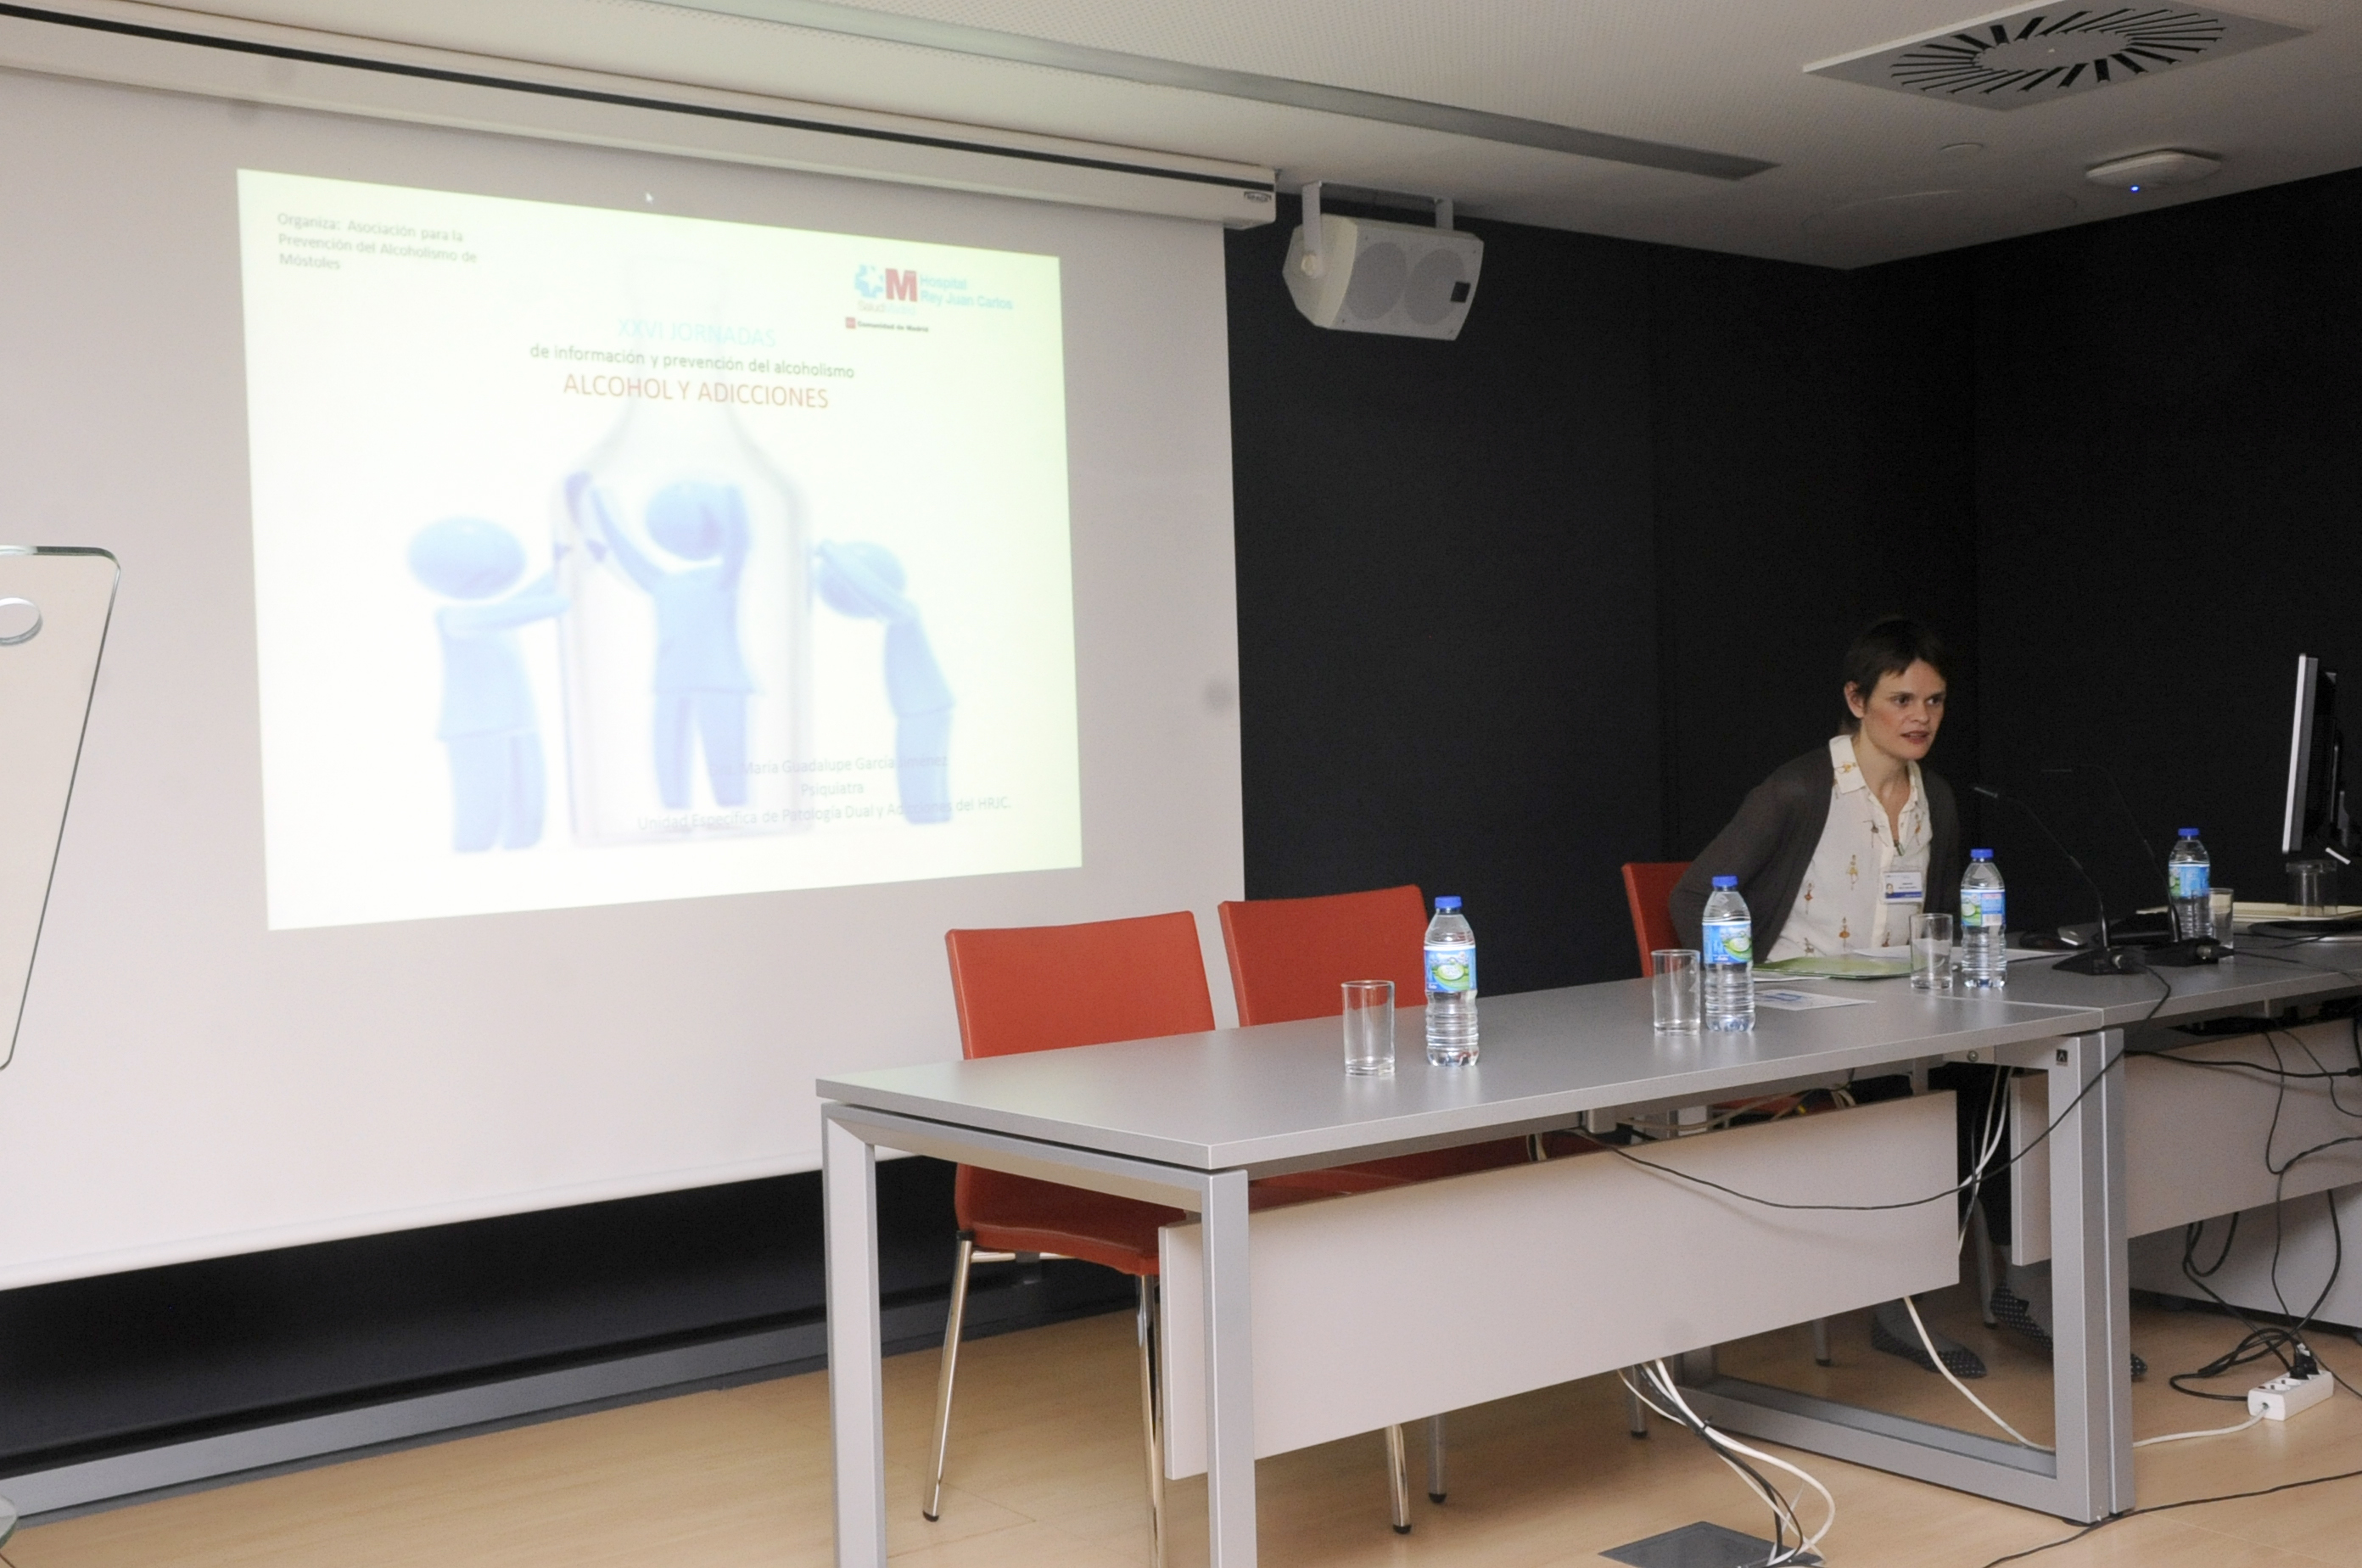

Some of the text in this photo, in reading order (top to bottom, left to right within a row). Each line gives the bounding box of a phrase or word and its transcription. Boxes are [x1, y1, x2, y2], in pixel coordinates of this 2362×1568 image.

[277, 213, 463, 242] Organiza: Asociación para la
[278, 233, 477, 263] Prevención del Alcoholismo de
[279, 253, 340, 270] Móstoles
[920, 274, 967, 290] Hospital
[921, 290, 1013, 310] Rey Juan Carlos
[618, 318, 776, 348] XXVI JORNADAS
[529, 343, 855, 378] de información y prevención del alcoholismo
[563, 373, 829, 409] ALCOHOL Y ADICCIONES
[782, 757, 852, 774] Guadalupe
[855, 755, 894, 770] García
[801, 782, 864, 797] Psiquiatra
[638, 815, 688, 832] Unidad
[691, 810, 757, 828] Específica
[762, 811, 778, 823] de
[782, 807, 842, 823] Patología
[846, 804, 875, 819] Dual
[876, 807, 884, 819] y
[956, 798, 974, 811] del
